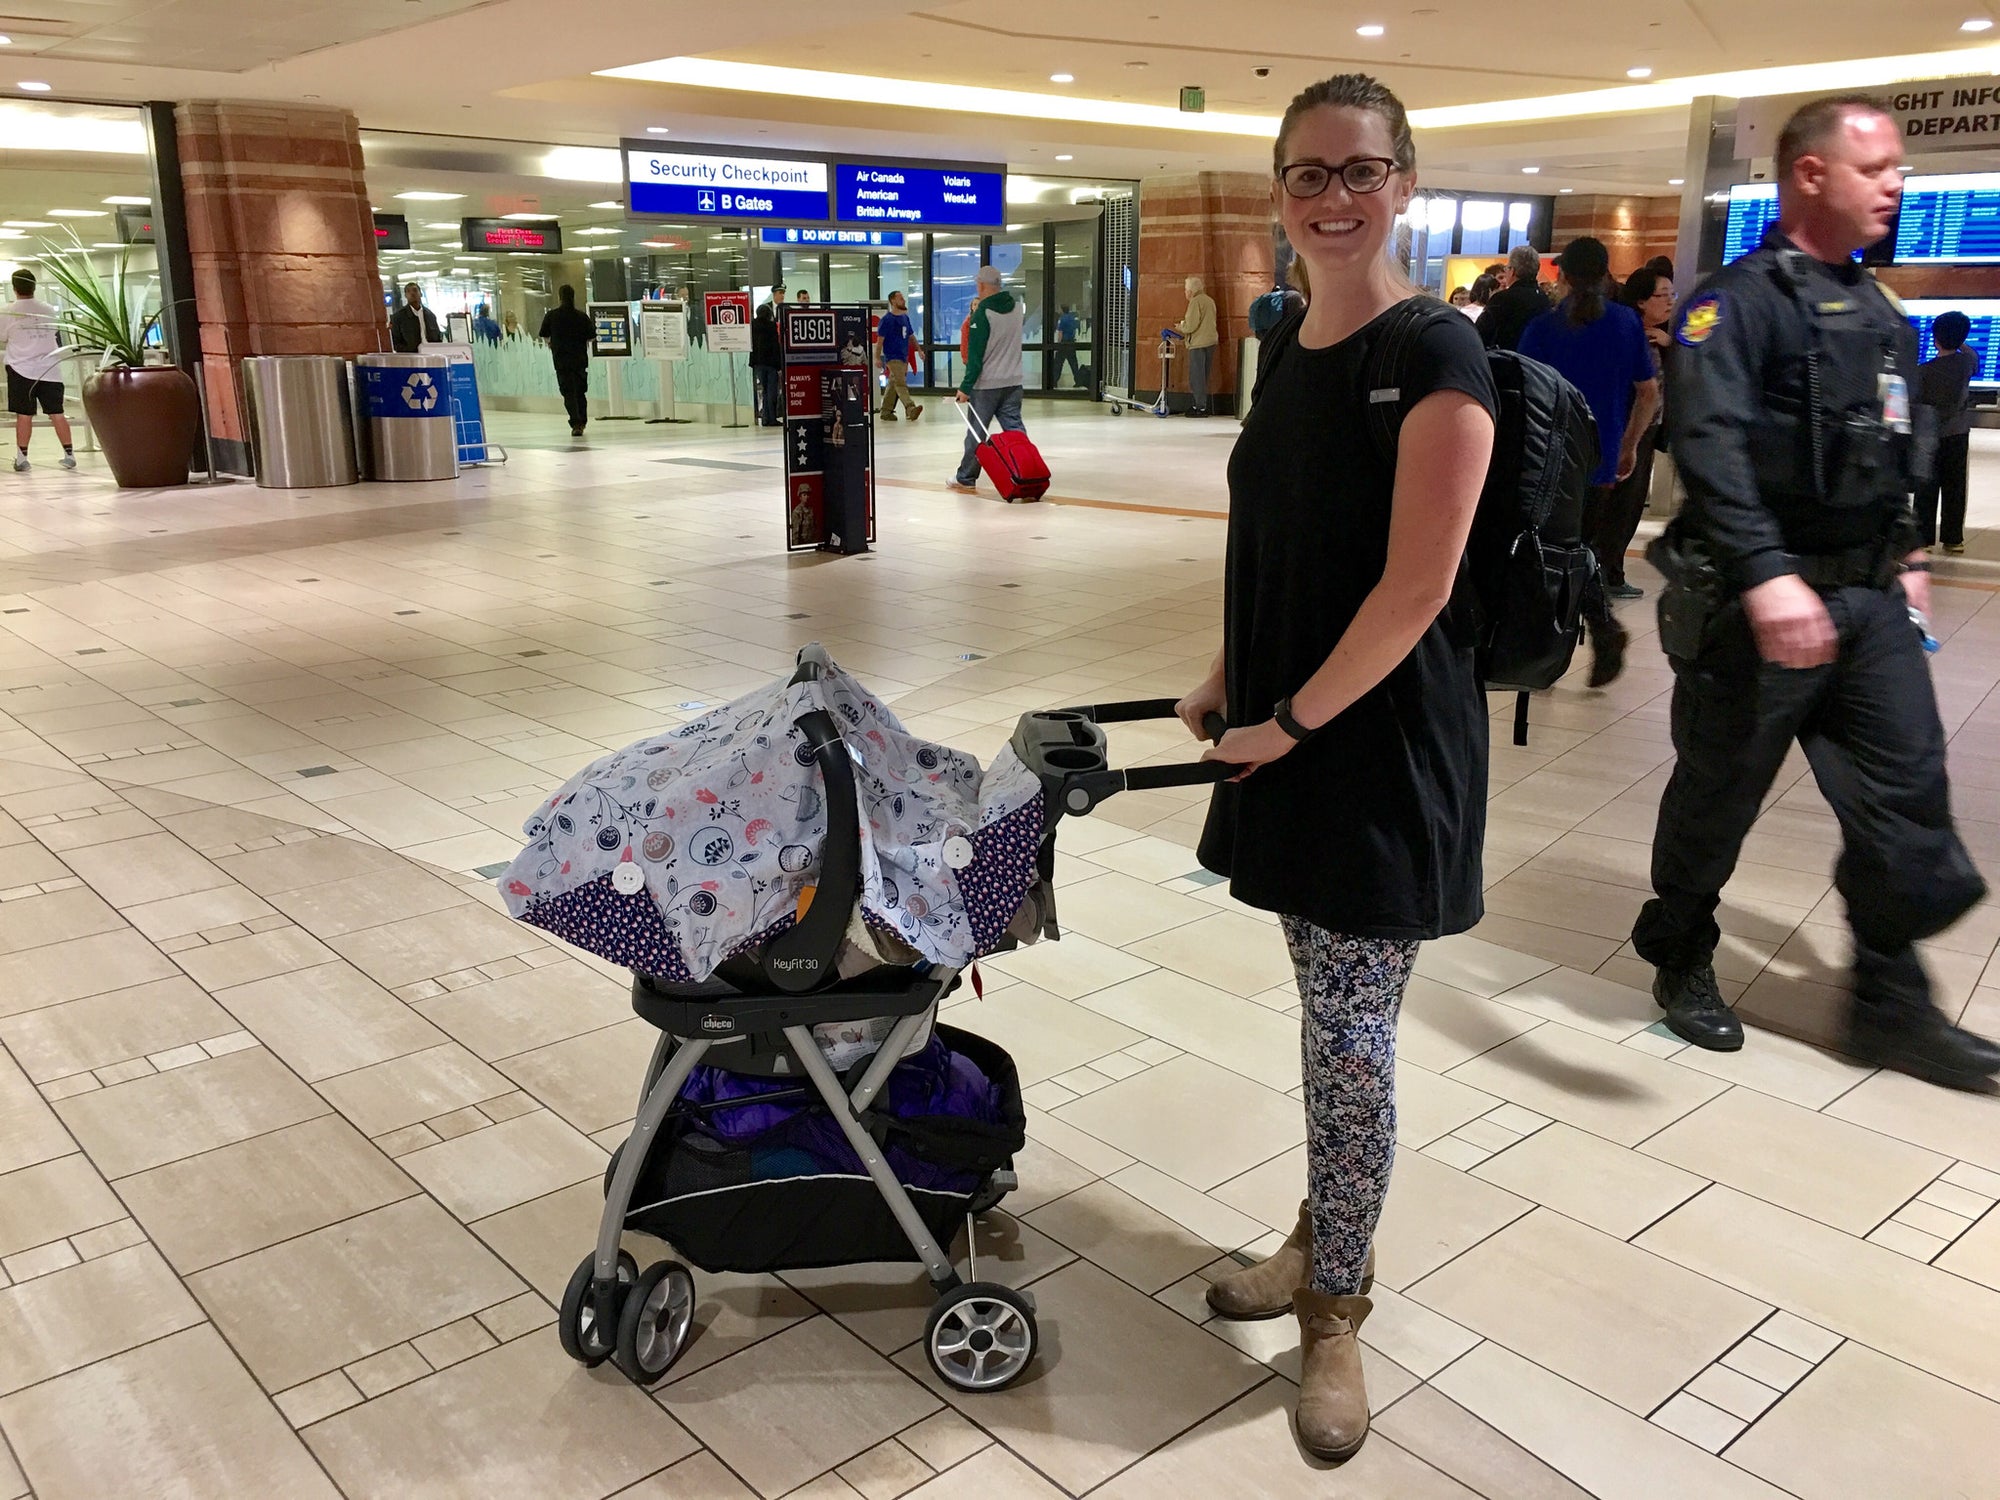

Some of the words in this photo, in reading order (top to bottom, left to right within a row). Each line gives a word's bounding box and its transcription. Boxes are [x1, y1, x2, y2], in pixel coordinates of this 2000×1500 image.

[1893, 90, 1944, 111] GHT
[650, 159, 716, 182] Security
[722, 164, 808, 184] Checkpoint
[856, 171, 869, 182] Air
[871, 172, 905, 184] Canada
[943, 176, 971, 187] Volaris
[857, 188, 899, 201] American
[943, 192, 977, 204] WestJet
[721, 194, 732, 209] B
[735, 194, 773, 211] Gates
[856, 206, 885, 218] British
[886, 207, 922, 221] Airways
[802, 229, 816, 240] DO
[818, 230, 837, 241] NOT
[838, 231, 867, 242] ENTER
[799, 319, 826, 340] USO
[367, 372, 381, 382] LE
[805, 959, 818, 969] 30
[703, 1018, 732, 1029] chicco
